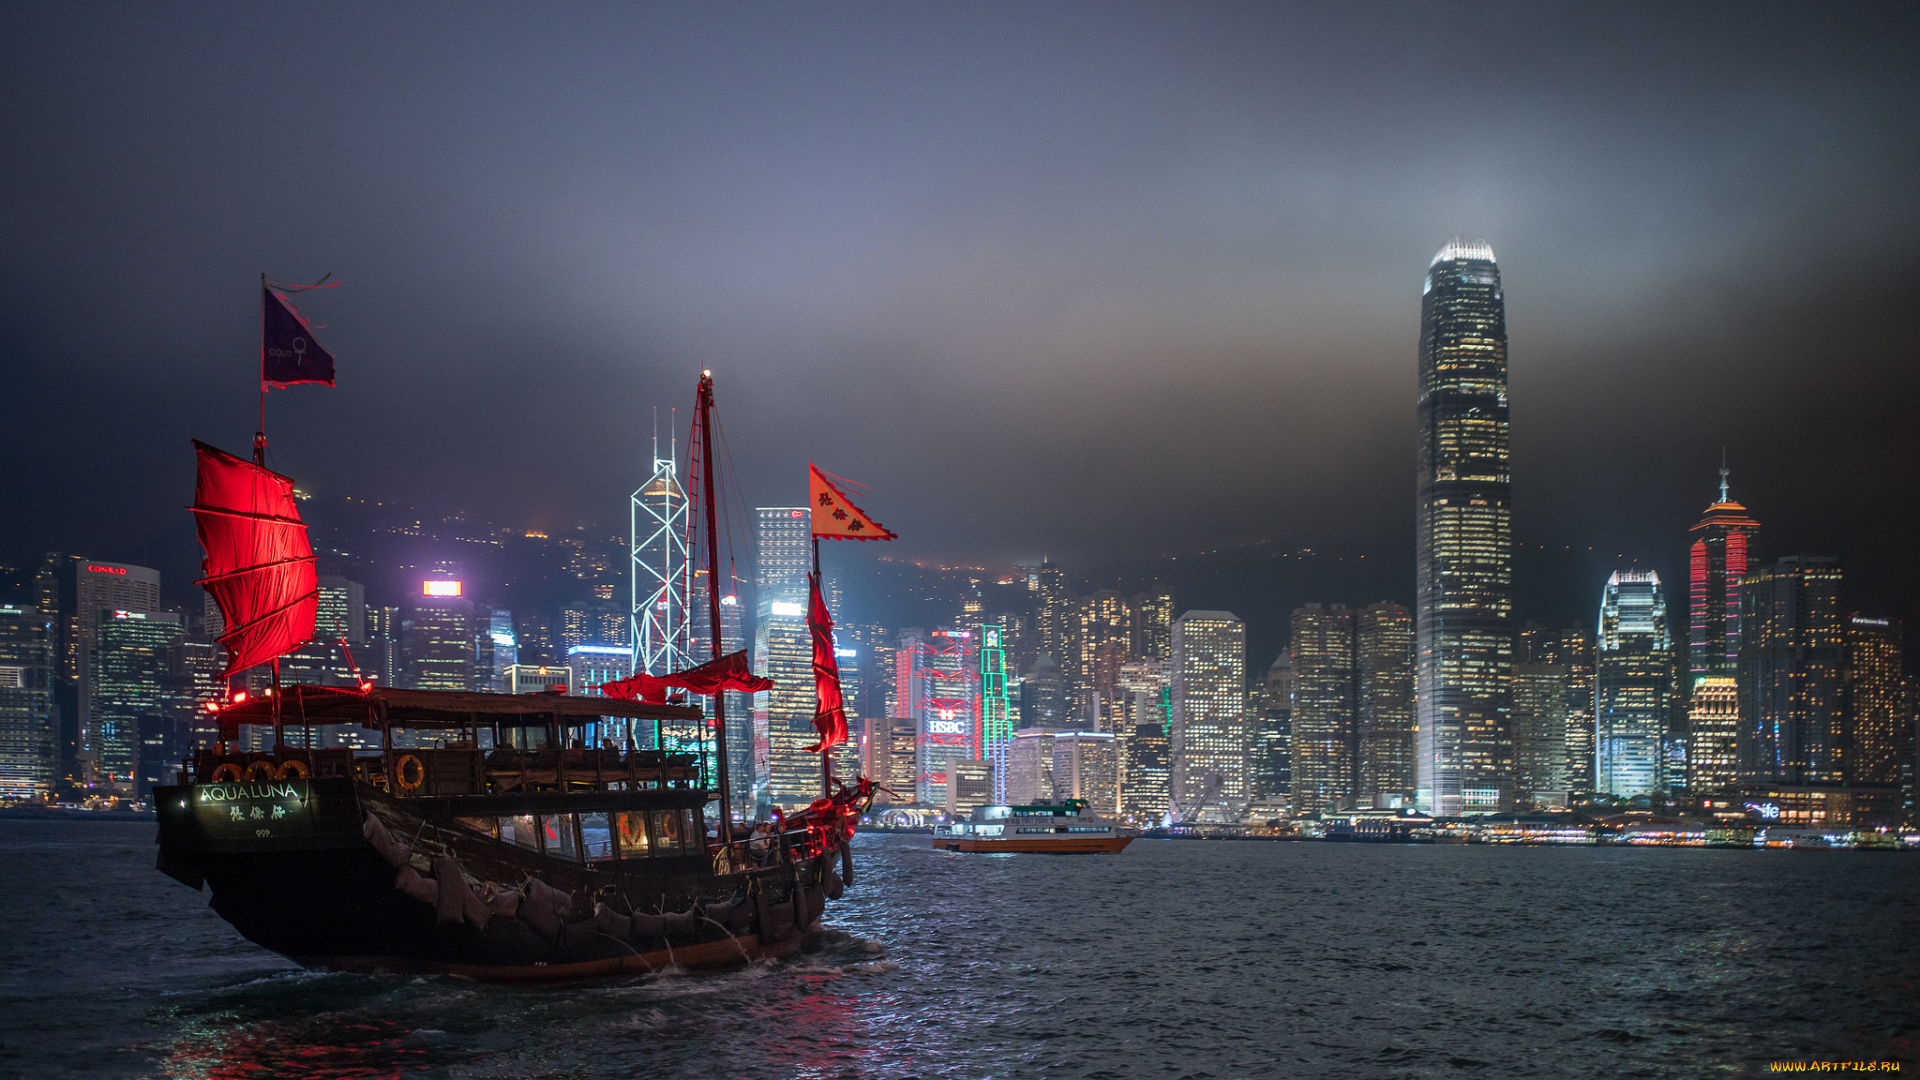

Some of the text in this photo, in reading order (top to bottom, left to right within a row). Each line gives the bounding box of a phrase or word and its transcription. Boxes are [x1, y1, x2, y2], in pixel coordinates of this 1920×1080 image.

[87, 565, 127, 575] CONRAD
[929, 721, 965, 733] HSBC
[200, 784, 298, 801] AQUA LUNA
